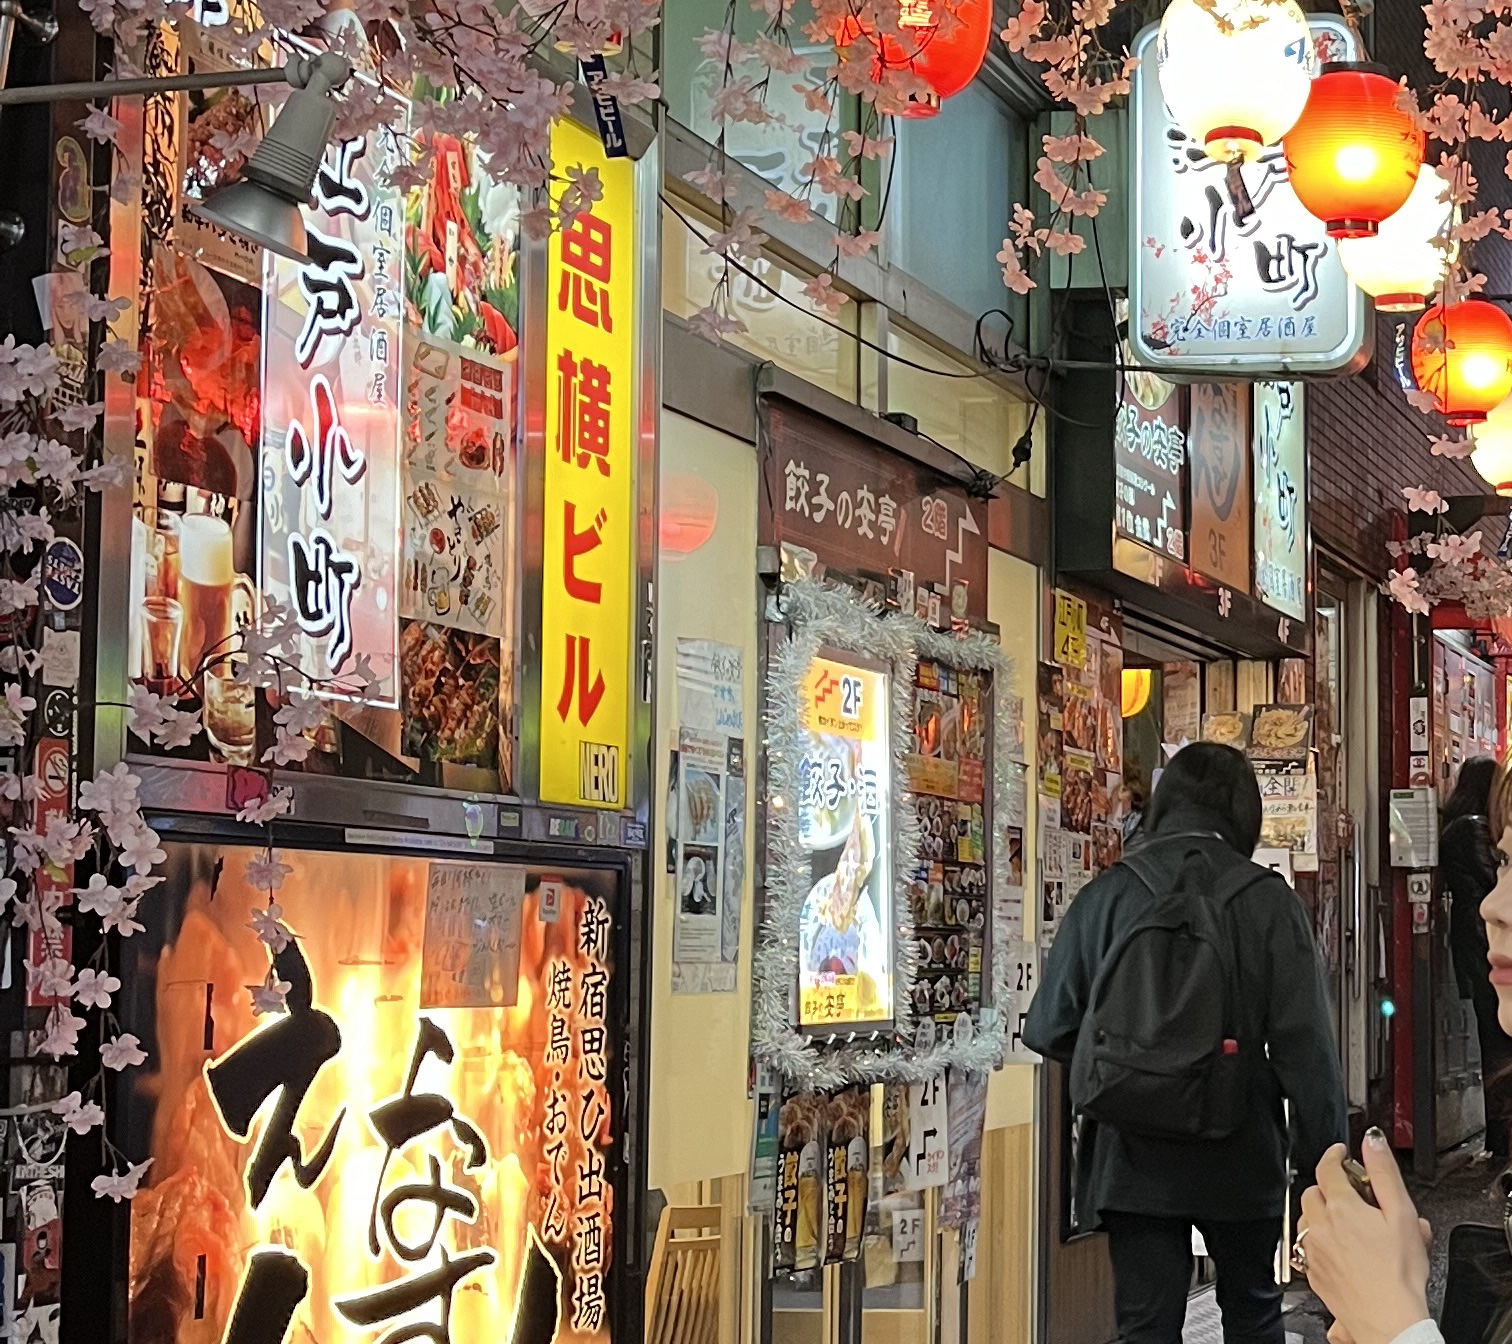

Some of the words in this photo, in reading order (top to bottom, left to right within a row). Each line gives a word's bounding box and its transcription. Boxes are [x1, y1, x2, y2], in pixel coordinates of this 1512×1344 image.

[1169, 317, 1319, 343] 完全個室居酒屋
[555, 203, 614, 729] 思横ビル
[784, 458, 898, 546] 餃子の安亭
[921, 495, 948, 541] 2階
[1216, 586, 1232, 618] 3F
[840, 675, 864, 719] 2F
[578, 740, 620, 804] NERO
[1016, 962, 1033, 992] 2F
[543, 961, 574, 1240] 焼鳥・おでん
[572, 899, 611, 1332] 新宿思ひ出酒場
[920, 1080, 940, 1107] 2F
[900, 1218, 921, 1236] 2F
